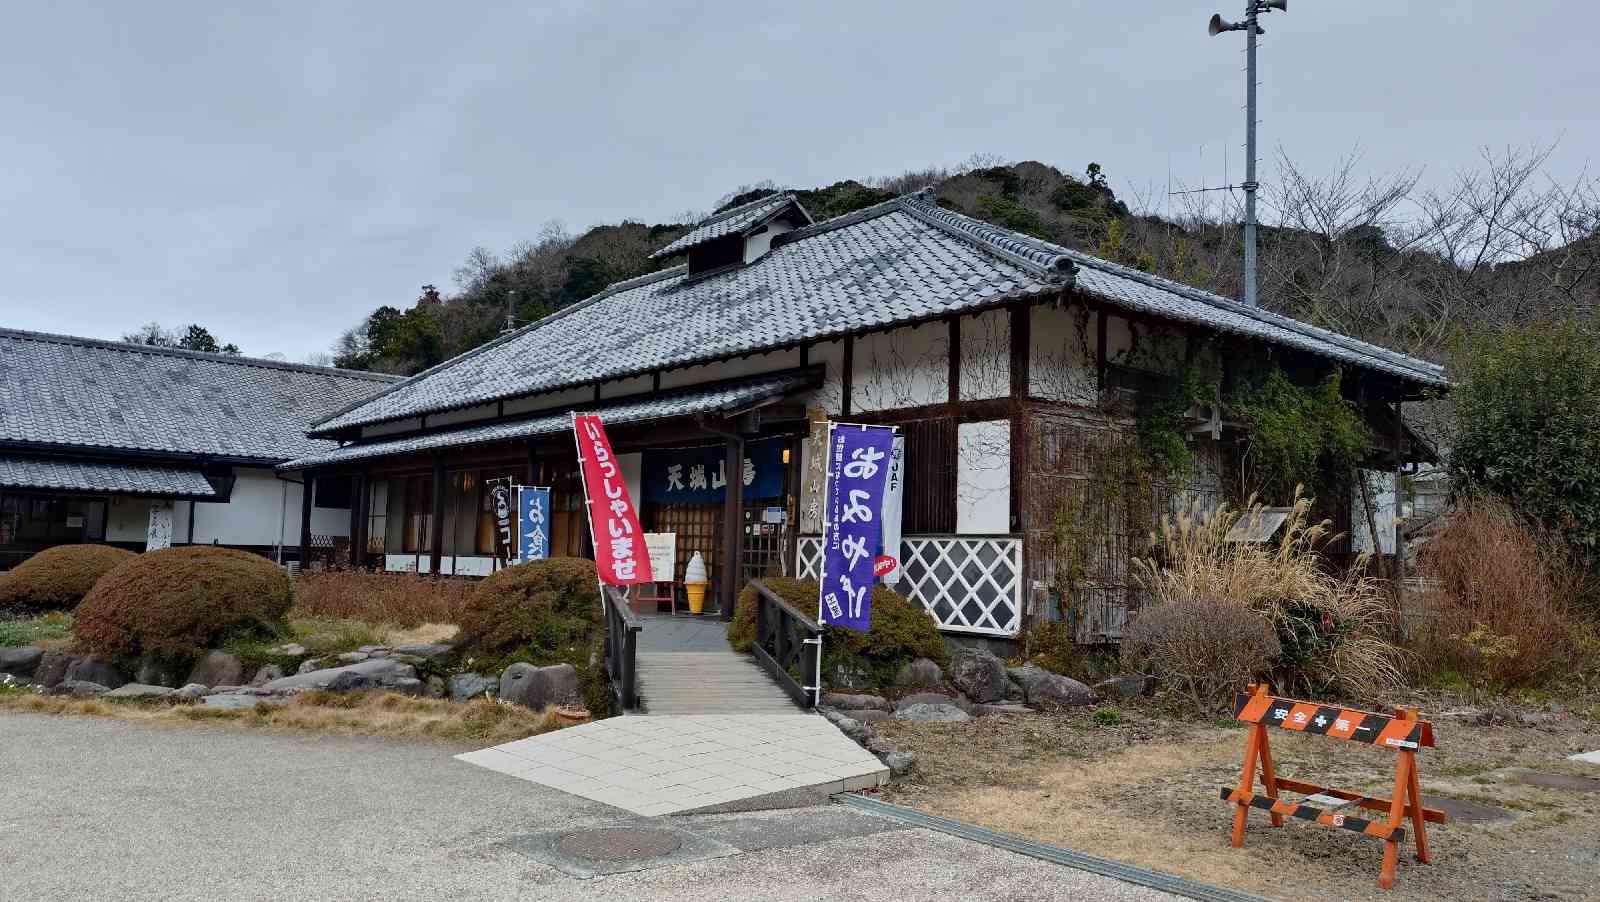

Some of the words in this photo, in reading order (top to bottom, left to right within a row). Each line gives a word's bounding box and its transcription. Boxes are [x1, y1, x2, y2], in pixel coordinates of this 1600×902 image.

[584, 421, 636, 580] いらっしゃいませ
[890, 462, 899, 491] JAF
[524, 497, 548, 560] お食
